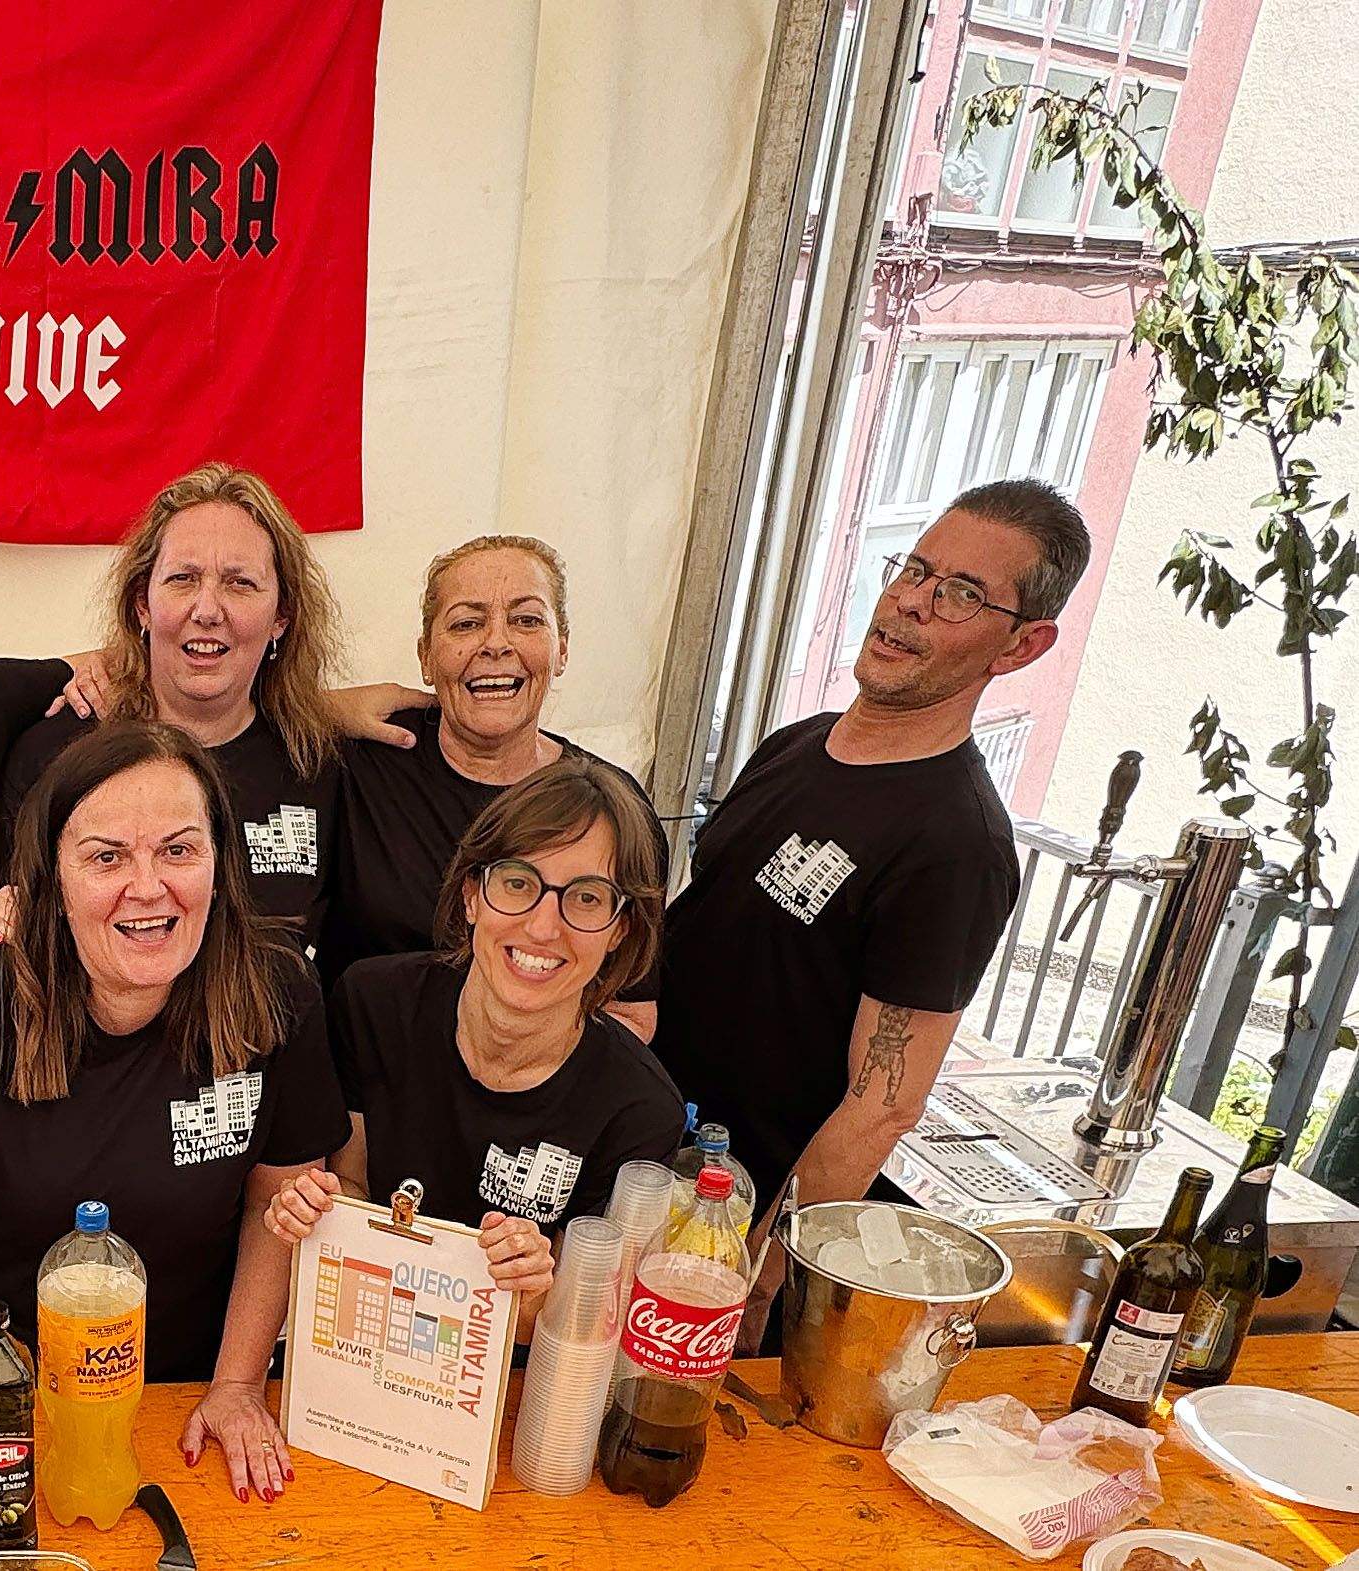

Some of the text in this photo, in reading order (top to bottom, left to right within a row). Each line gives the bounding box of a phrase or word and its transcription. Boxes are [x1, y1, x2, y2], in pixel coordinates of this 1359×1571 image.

[251, 863, 274, 874] SAN
[174, 1132, 237, 1153] ALTAMIRA
[174, 1151, 201, 1166] SAN
[479, 1178, 538, 1211] ALTAMIRA
[320, 1242, 342, 1258] EU
[394, 1261, 468, 1303] QUERO
[85, 1337, 136, 1365] KAS
[312, 1346, 372, 1369] TRABALLAR
[335, 1340, 372, 1359] VIVIR
[457, 1287, 496, 1418] ALTAMIRA
[633, 1342, 673, 1365] SABOR
[76, 1356, 138, 1377] NARANJA
[440, 1359, 459, 1386] EN
[383, 1381, 454, 1410] DESFRUTAR
[385, 1370, 455, 1399] COMPRAR
[2, 1481, 26, 1491] Extra
